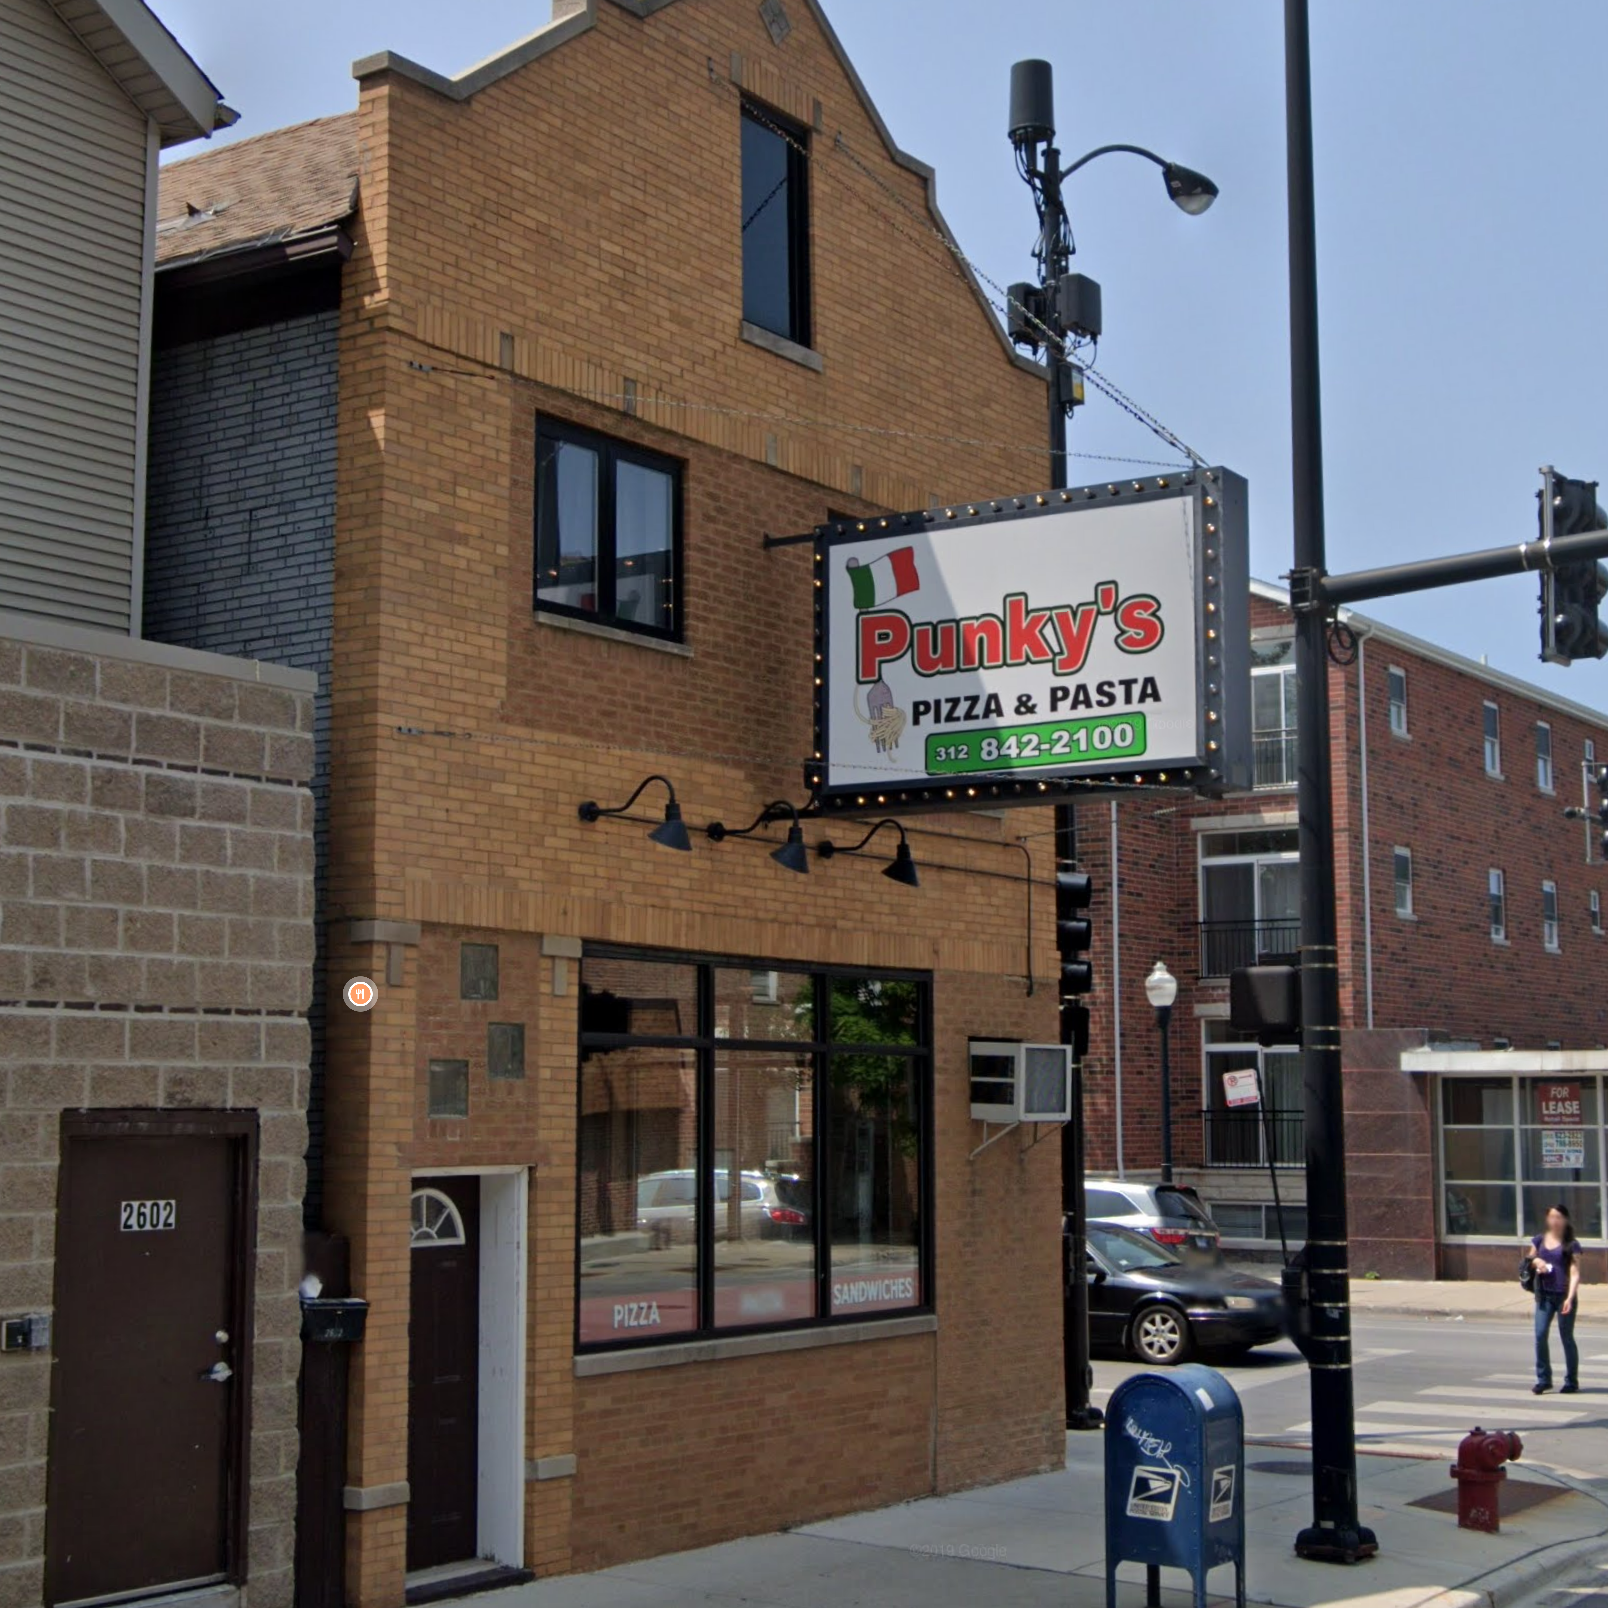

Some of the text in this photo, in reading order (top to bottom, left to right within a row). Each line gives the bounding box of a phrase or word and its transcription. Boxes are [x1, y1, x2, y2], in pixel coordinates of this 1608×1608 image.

[856, 580, 1165, 684] Punky's
[912, 676, 1162, 726] PIZZA & PASTA
[935, 743, 970, 762] 312
[979, 723, 1136, 762] 842-2100
[1542, 1101, 1581, 1115] LEASE
[1550, 1086, 1570, 1099] FOR
[122, 1201, 174, 1230] 2602
[613, 1277, 914, 1329] PIZZA SANDWICHES
